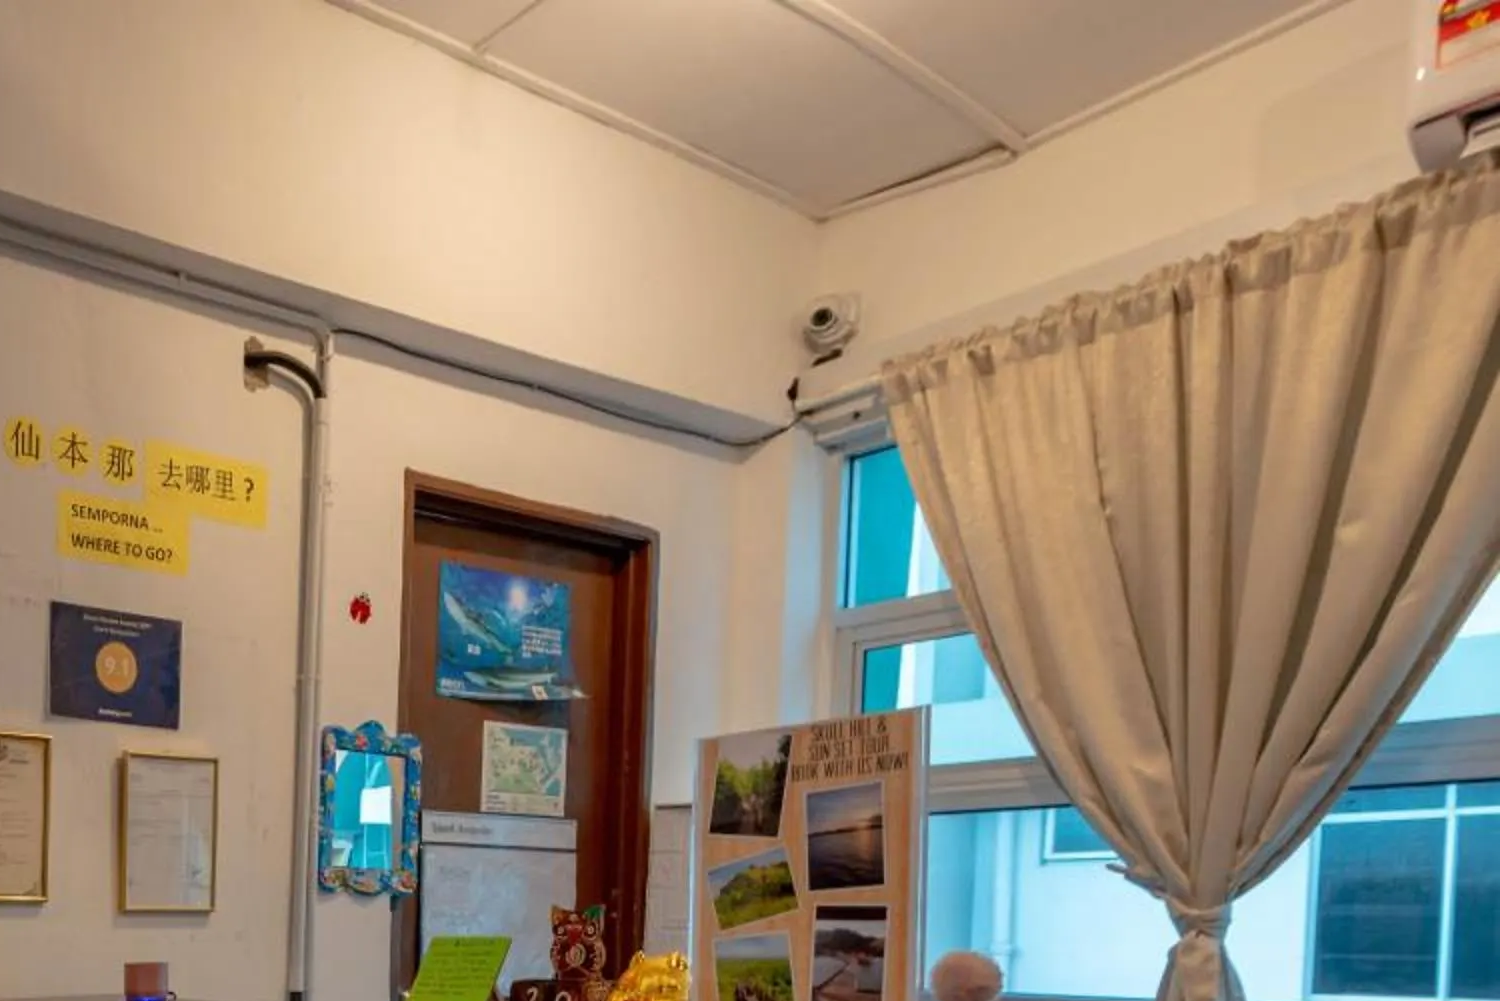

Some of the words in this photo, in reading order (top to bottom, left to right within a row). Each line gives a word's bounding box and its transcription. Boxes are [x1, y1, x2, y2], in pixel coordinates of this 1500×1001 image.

[71, 503, 149, 530] SEMPORNA
[71, 532, 120, 555] WHERE
[124, 541, 143, 558] TO
[145, 546, 173, 563] GO?
[823, 757, 854, 778] WITH
